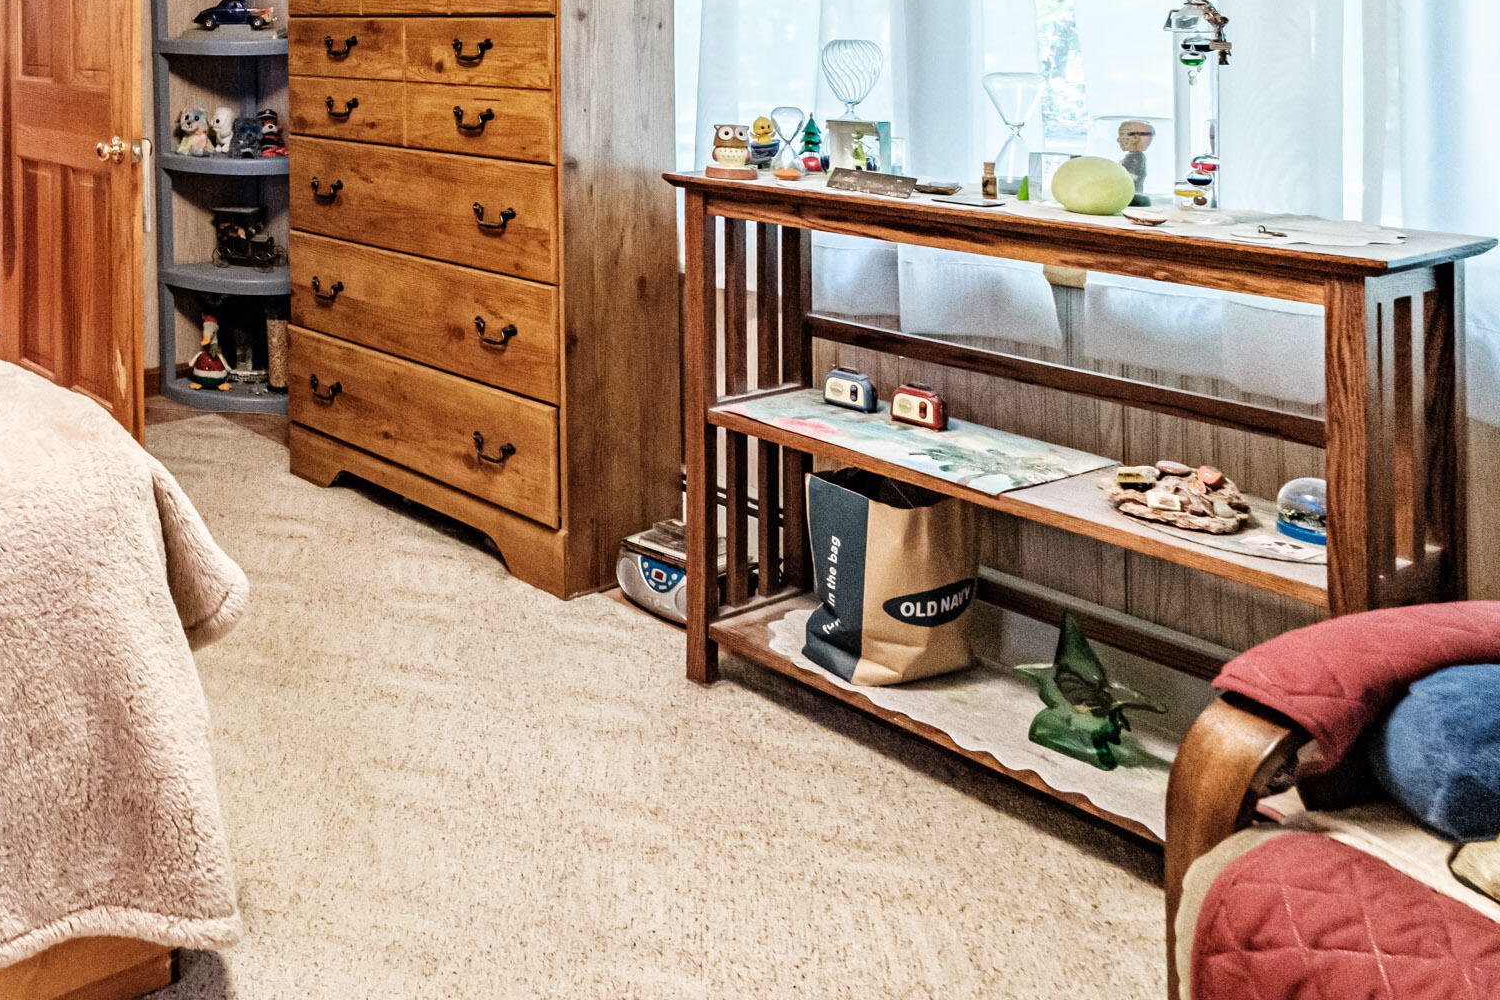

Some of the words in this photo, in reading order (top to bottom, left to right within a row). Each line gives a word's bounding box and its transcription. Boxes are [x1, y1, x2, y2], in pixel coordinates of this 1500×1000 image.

[827, 535, 841, 564] bag
[826, 566, 837, 590] the
[827, 592, 836, 608] in
[900, 601, 938, 617] OLD
[940, 585, 971, 613] NAVY
